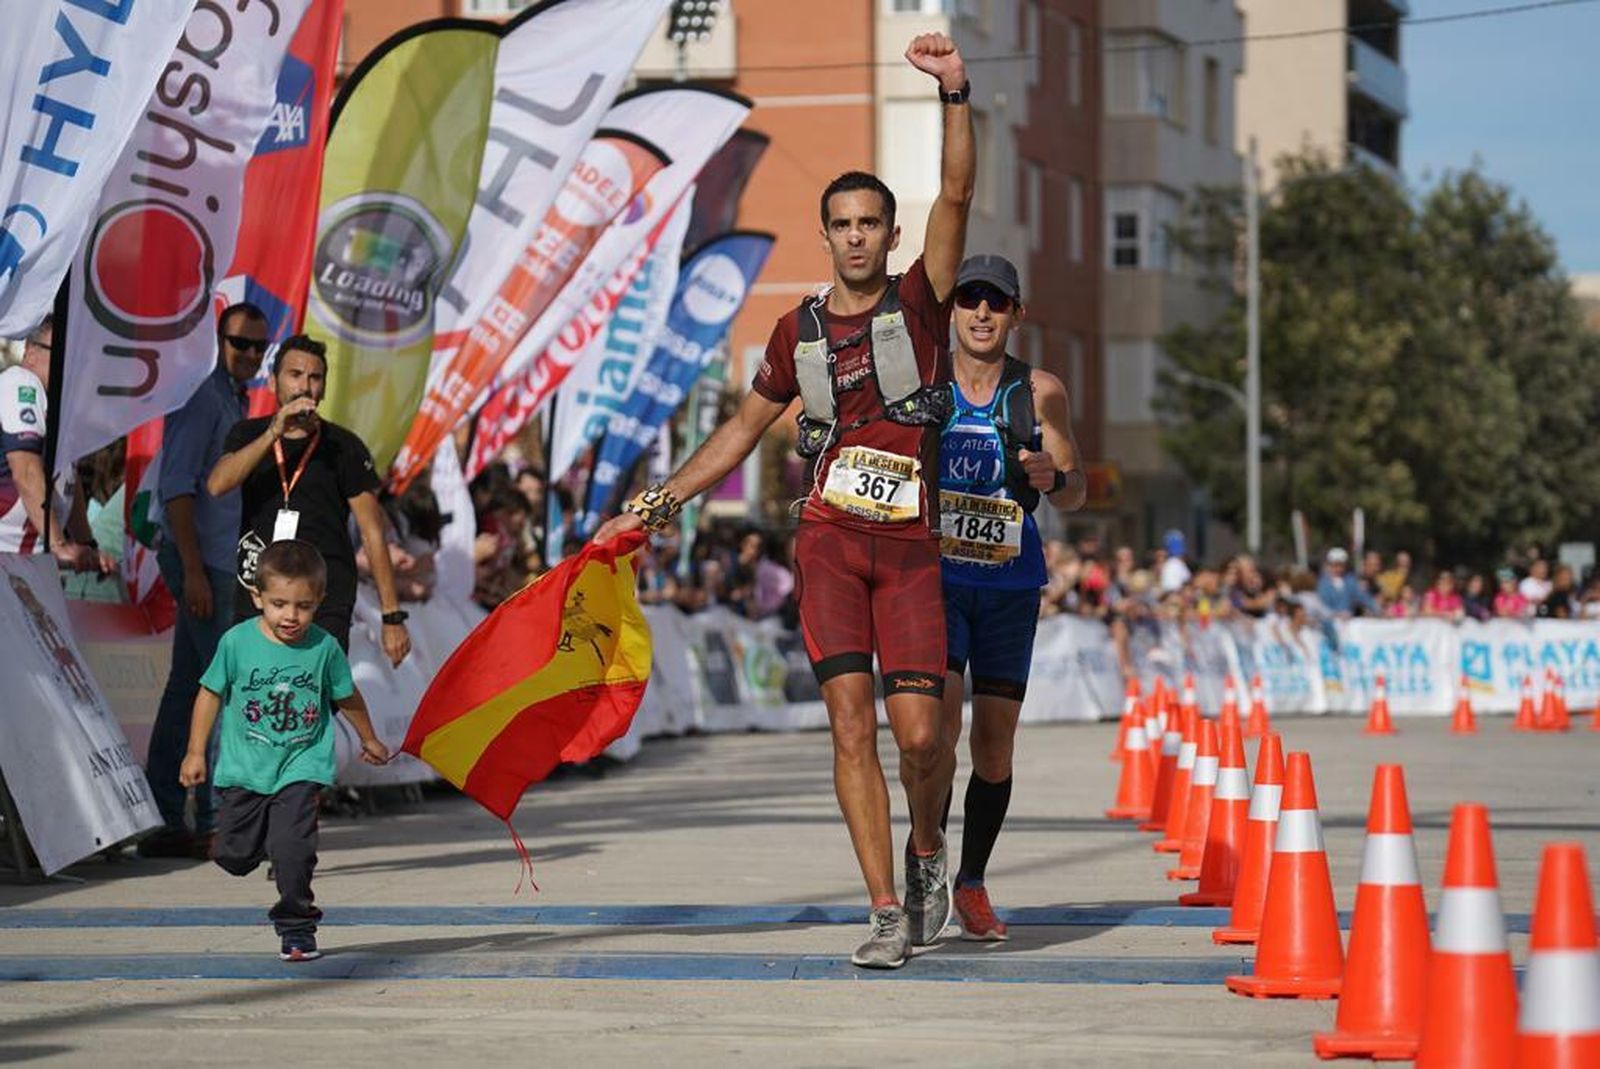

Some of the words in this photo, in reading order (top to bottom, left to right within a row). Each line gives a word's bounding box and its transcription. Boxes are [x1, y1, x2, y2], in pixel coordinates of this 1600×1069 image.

[319, 262, 424, 311] Loading
[855, 472, 900, 503] 367
[846, 504, 881, 521] asisa
[954, 515, 1006, 543] 1843
